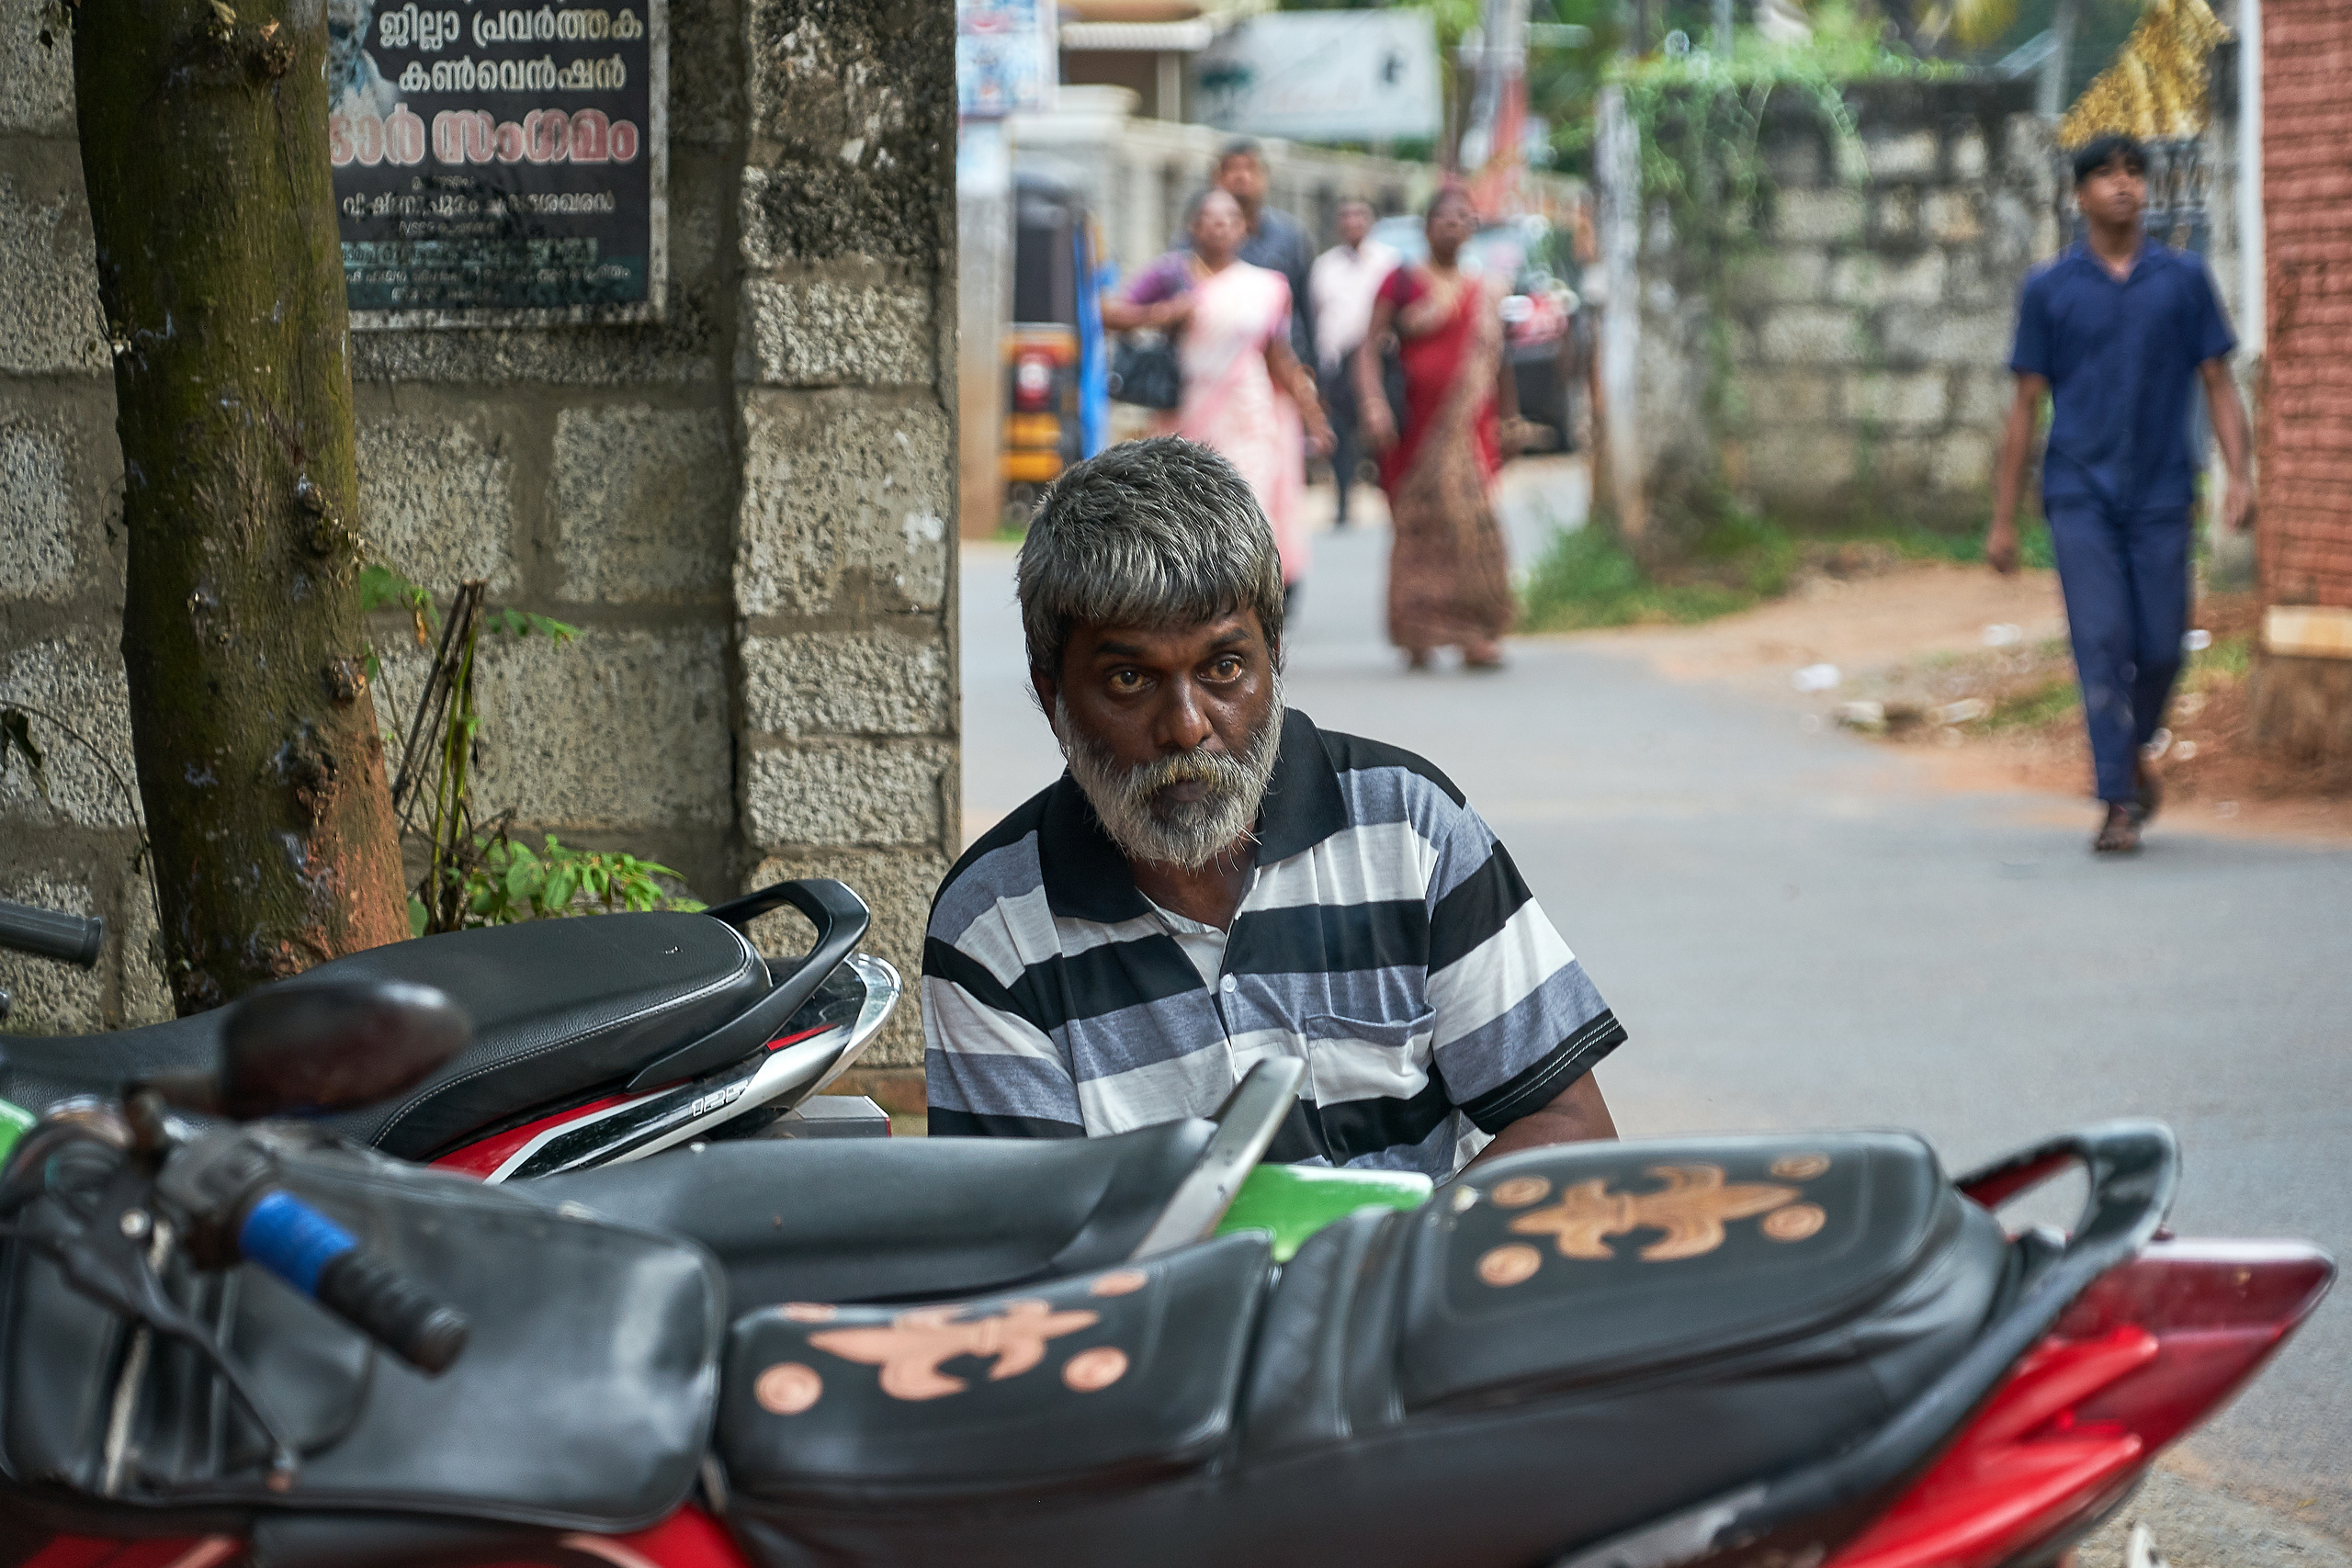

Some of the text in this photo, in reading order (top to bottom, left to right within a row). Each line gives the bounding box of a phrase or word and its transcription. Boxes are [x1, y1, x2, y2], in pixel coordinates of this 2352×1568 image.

[379, 3, 645, 51] ജില്ലാ പ്രവർത്തക
[398, 53, 627, 93] കൺവെൻഷൻ
[432, 107, 640, 166] സംഗമം
